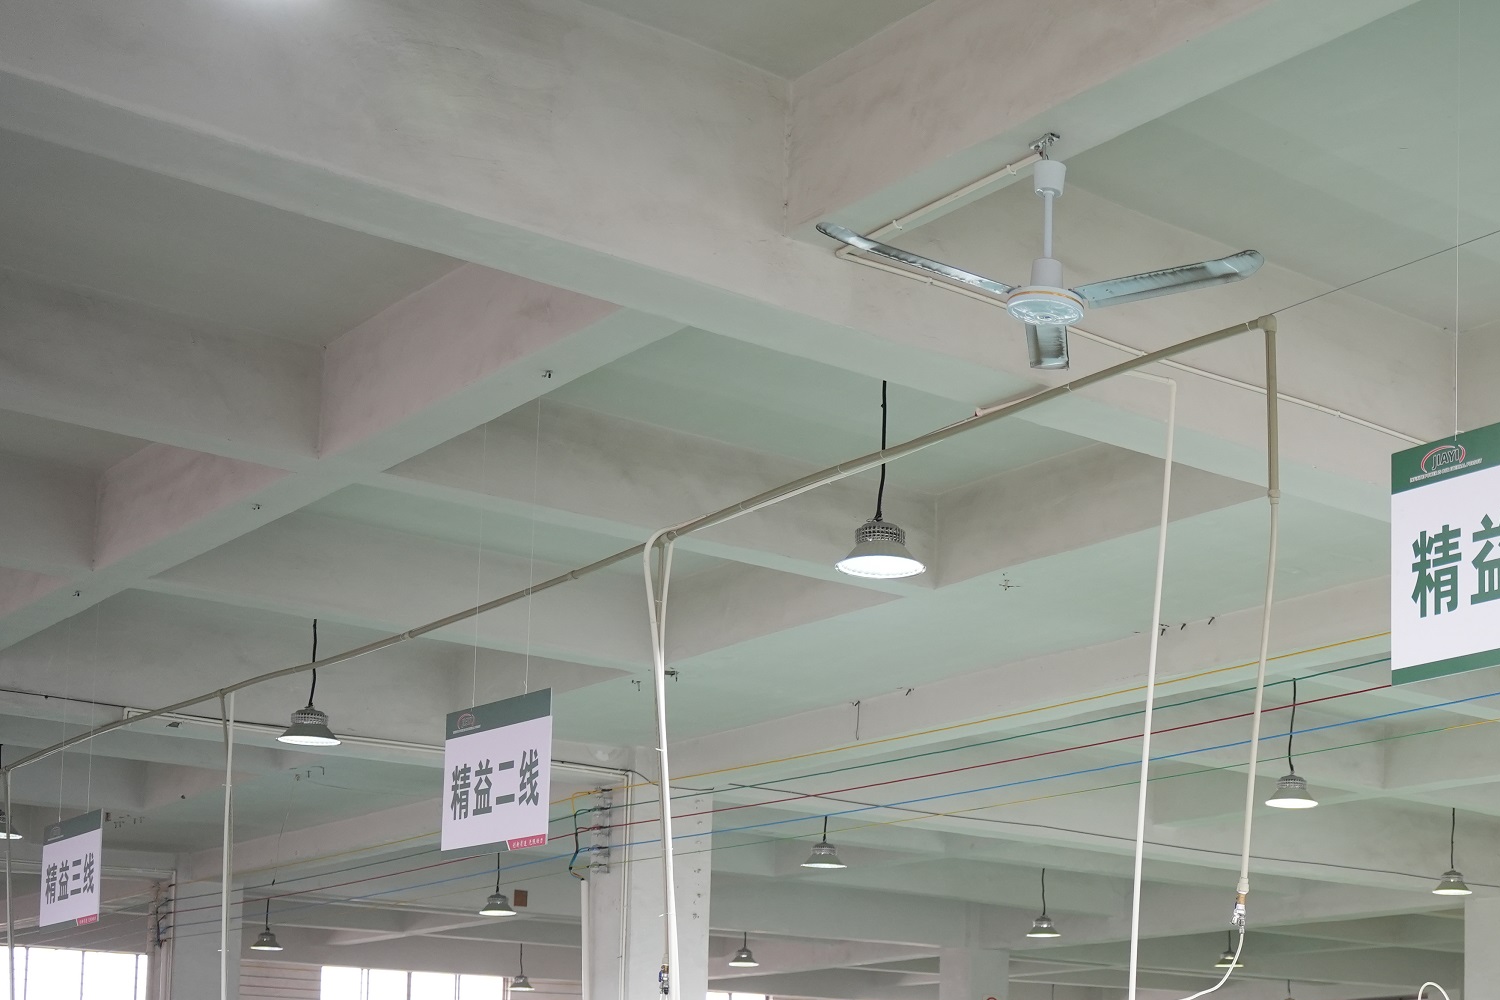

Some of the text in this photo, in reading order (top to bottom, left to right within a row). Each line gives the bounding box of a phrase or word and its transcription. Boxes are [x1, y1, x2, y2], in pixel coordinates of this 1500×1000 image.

[1432, 448, 1459, 470] JIAYI
[451, 749, 539, 820] 精益二线
[45, 852, 94, 904] 精益三线
